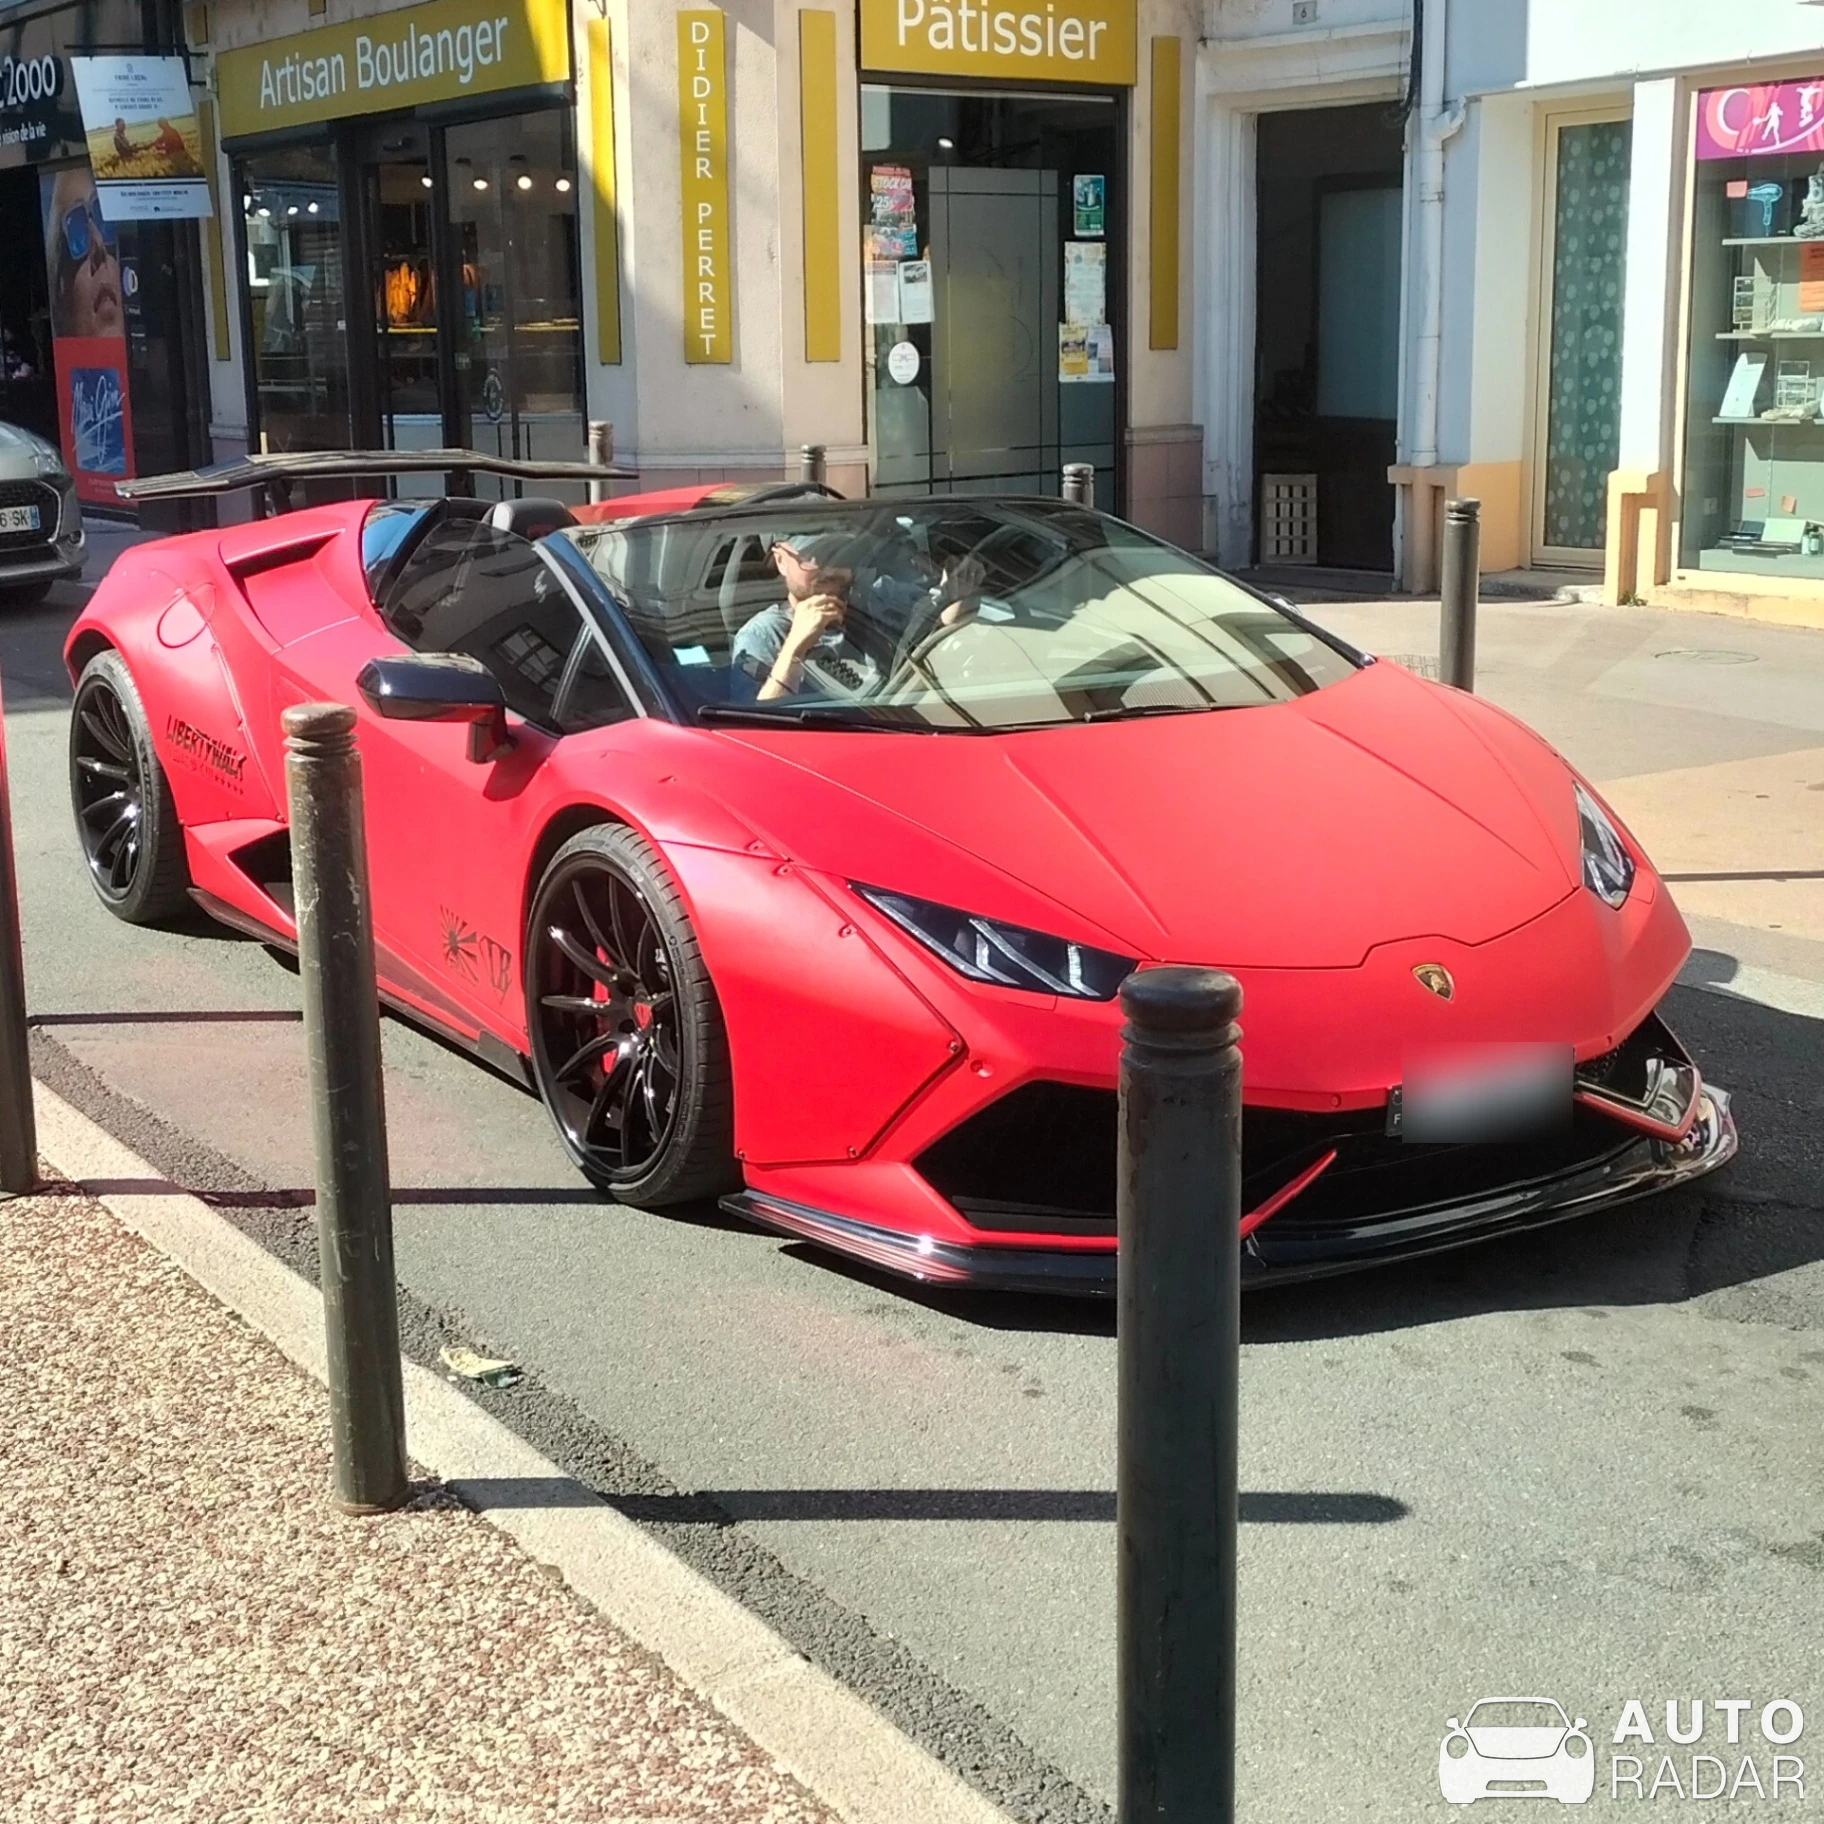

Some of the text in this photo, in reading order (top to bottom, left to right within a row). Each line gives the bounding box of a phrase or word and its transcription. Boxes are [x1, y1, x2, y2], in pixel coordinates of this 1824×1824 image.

[897, 0, 1107, 60] Pâtissier
[1301, 7, 1307, 18] 6
[260, 16, 508, 109] Artisan Boulanger
[36, 121, 46, 137] vie
[691, 22, 716, 355] DIDIER PERRET
